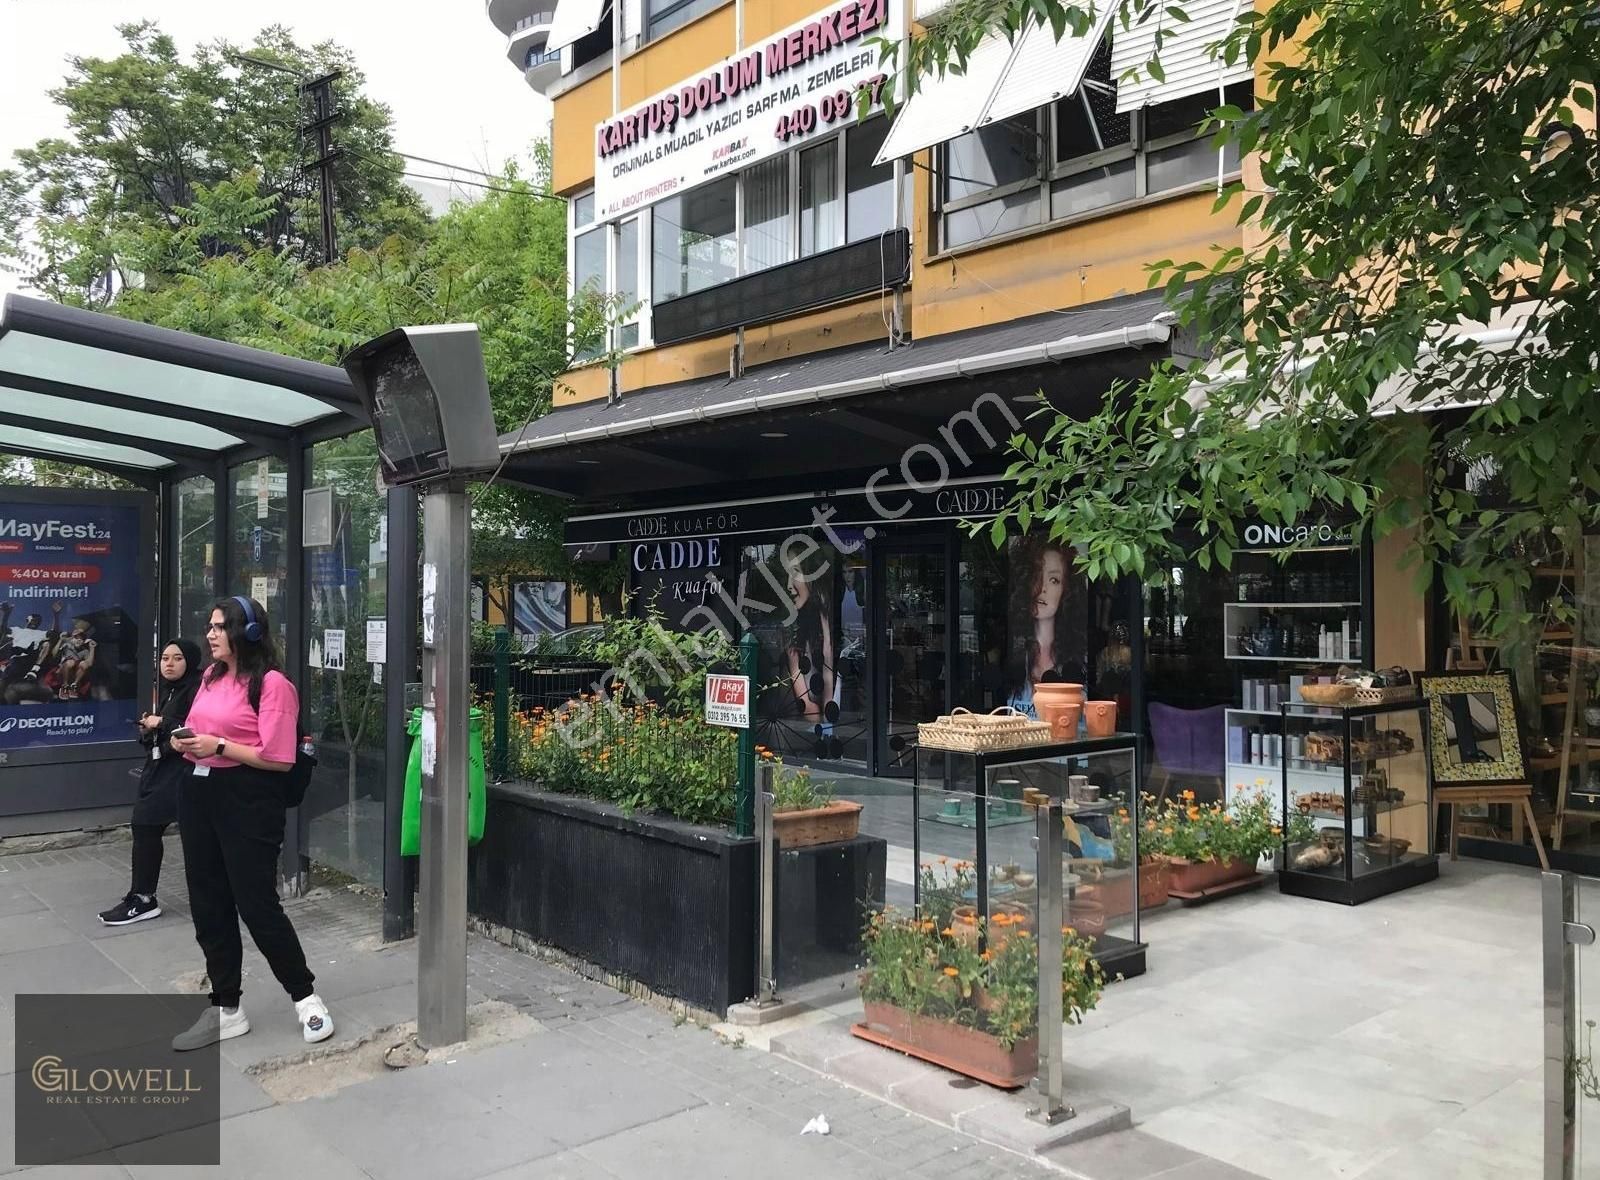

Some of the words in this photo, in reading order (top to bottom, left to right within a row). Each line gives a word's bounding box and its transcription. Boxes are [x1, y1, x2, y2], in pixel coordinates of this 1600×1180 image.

[598, 93, 679, 159] KARTUŞ
[680, 51, 762, 118] DOLUM
[774, 104, 816, 142] 440
[820, 89, 852, 123] 09
[706, 109, 742, 137] YAZICI
[704, 148, 756, 175] www.karbax.com
[712, 136, 749, 161] KARBAX
[608, 202, 621, 215] ALL
[622, 191, 644, 210] ABOUT
[645, 177, 678, 200] PRINTERS
[936, 486, 1005, 514] CADDE
[627, 516, 668, 537] CADDE
[674, 511, 738, 533] KUAFÖR
[633, 537, 721, 572] CADDE
[52, 570, 87, 579] varan
[9, 585, 89, 598] indirimler!
[18, 714, 95, 729] DECATHLON
[46, 728, 67, 736] Ready
[68, 727, 75, 735] to
